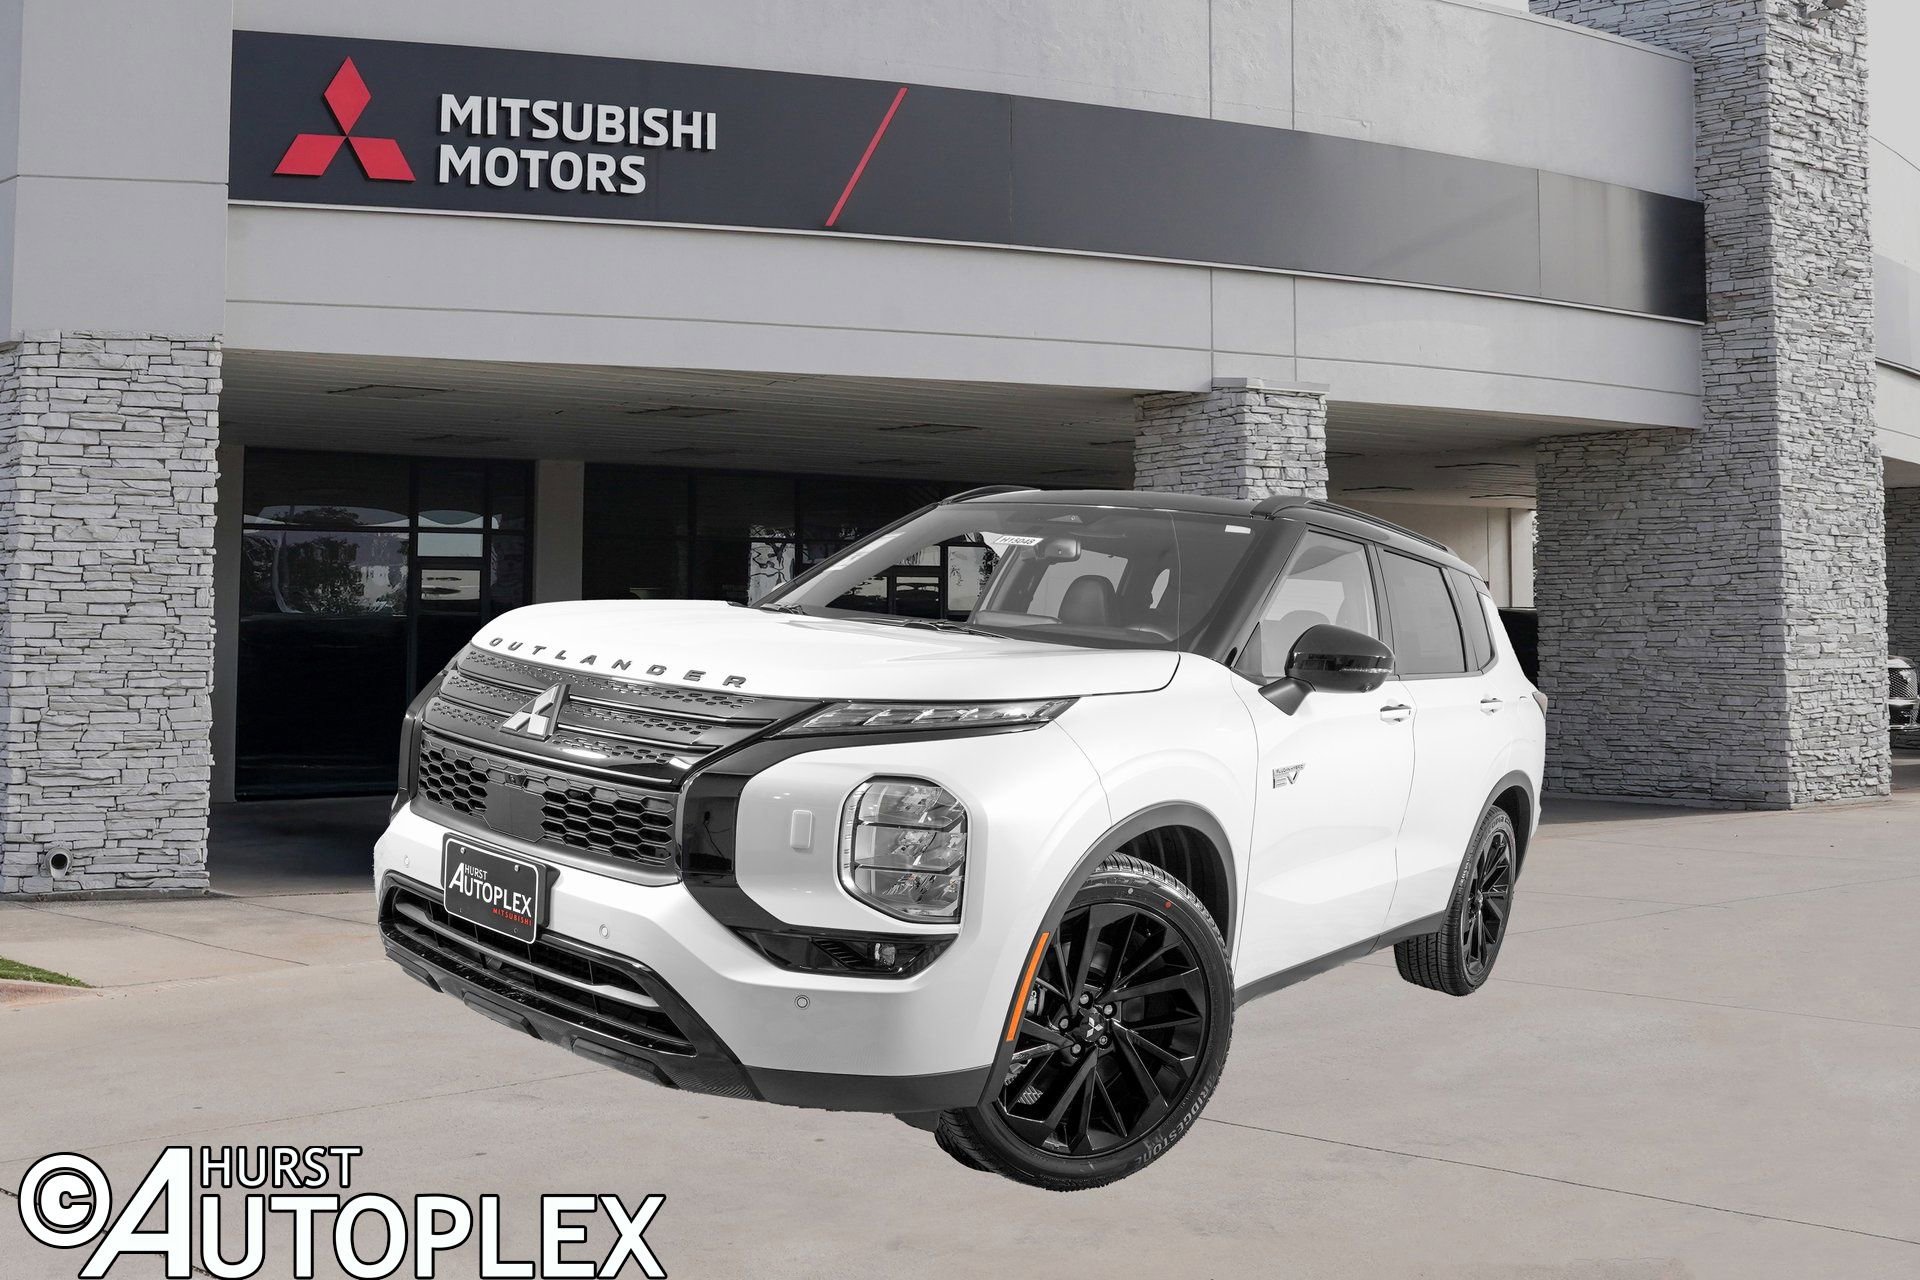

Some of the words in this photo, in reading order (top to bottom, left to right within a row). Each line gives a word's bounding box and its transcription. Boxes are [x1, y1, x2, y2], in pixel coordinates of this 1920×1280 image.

[439, 93, 717, 151] MITSUBISHI
[438, 144, 647, 194] MOTORS
[489, 637, 747, 688] OUTLANDER
[449, 862, 532, 918] AUTOPLEX
[464, 864, 487, 880] HURST
[492, 908, 533, 926] MITSUBISHI
